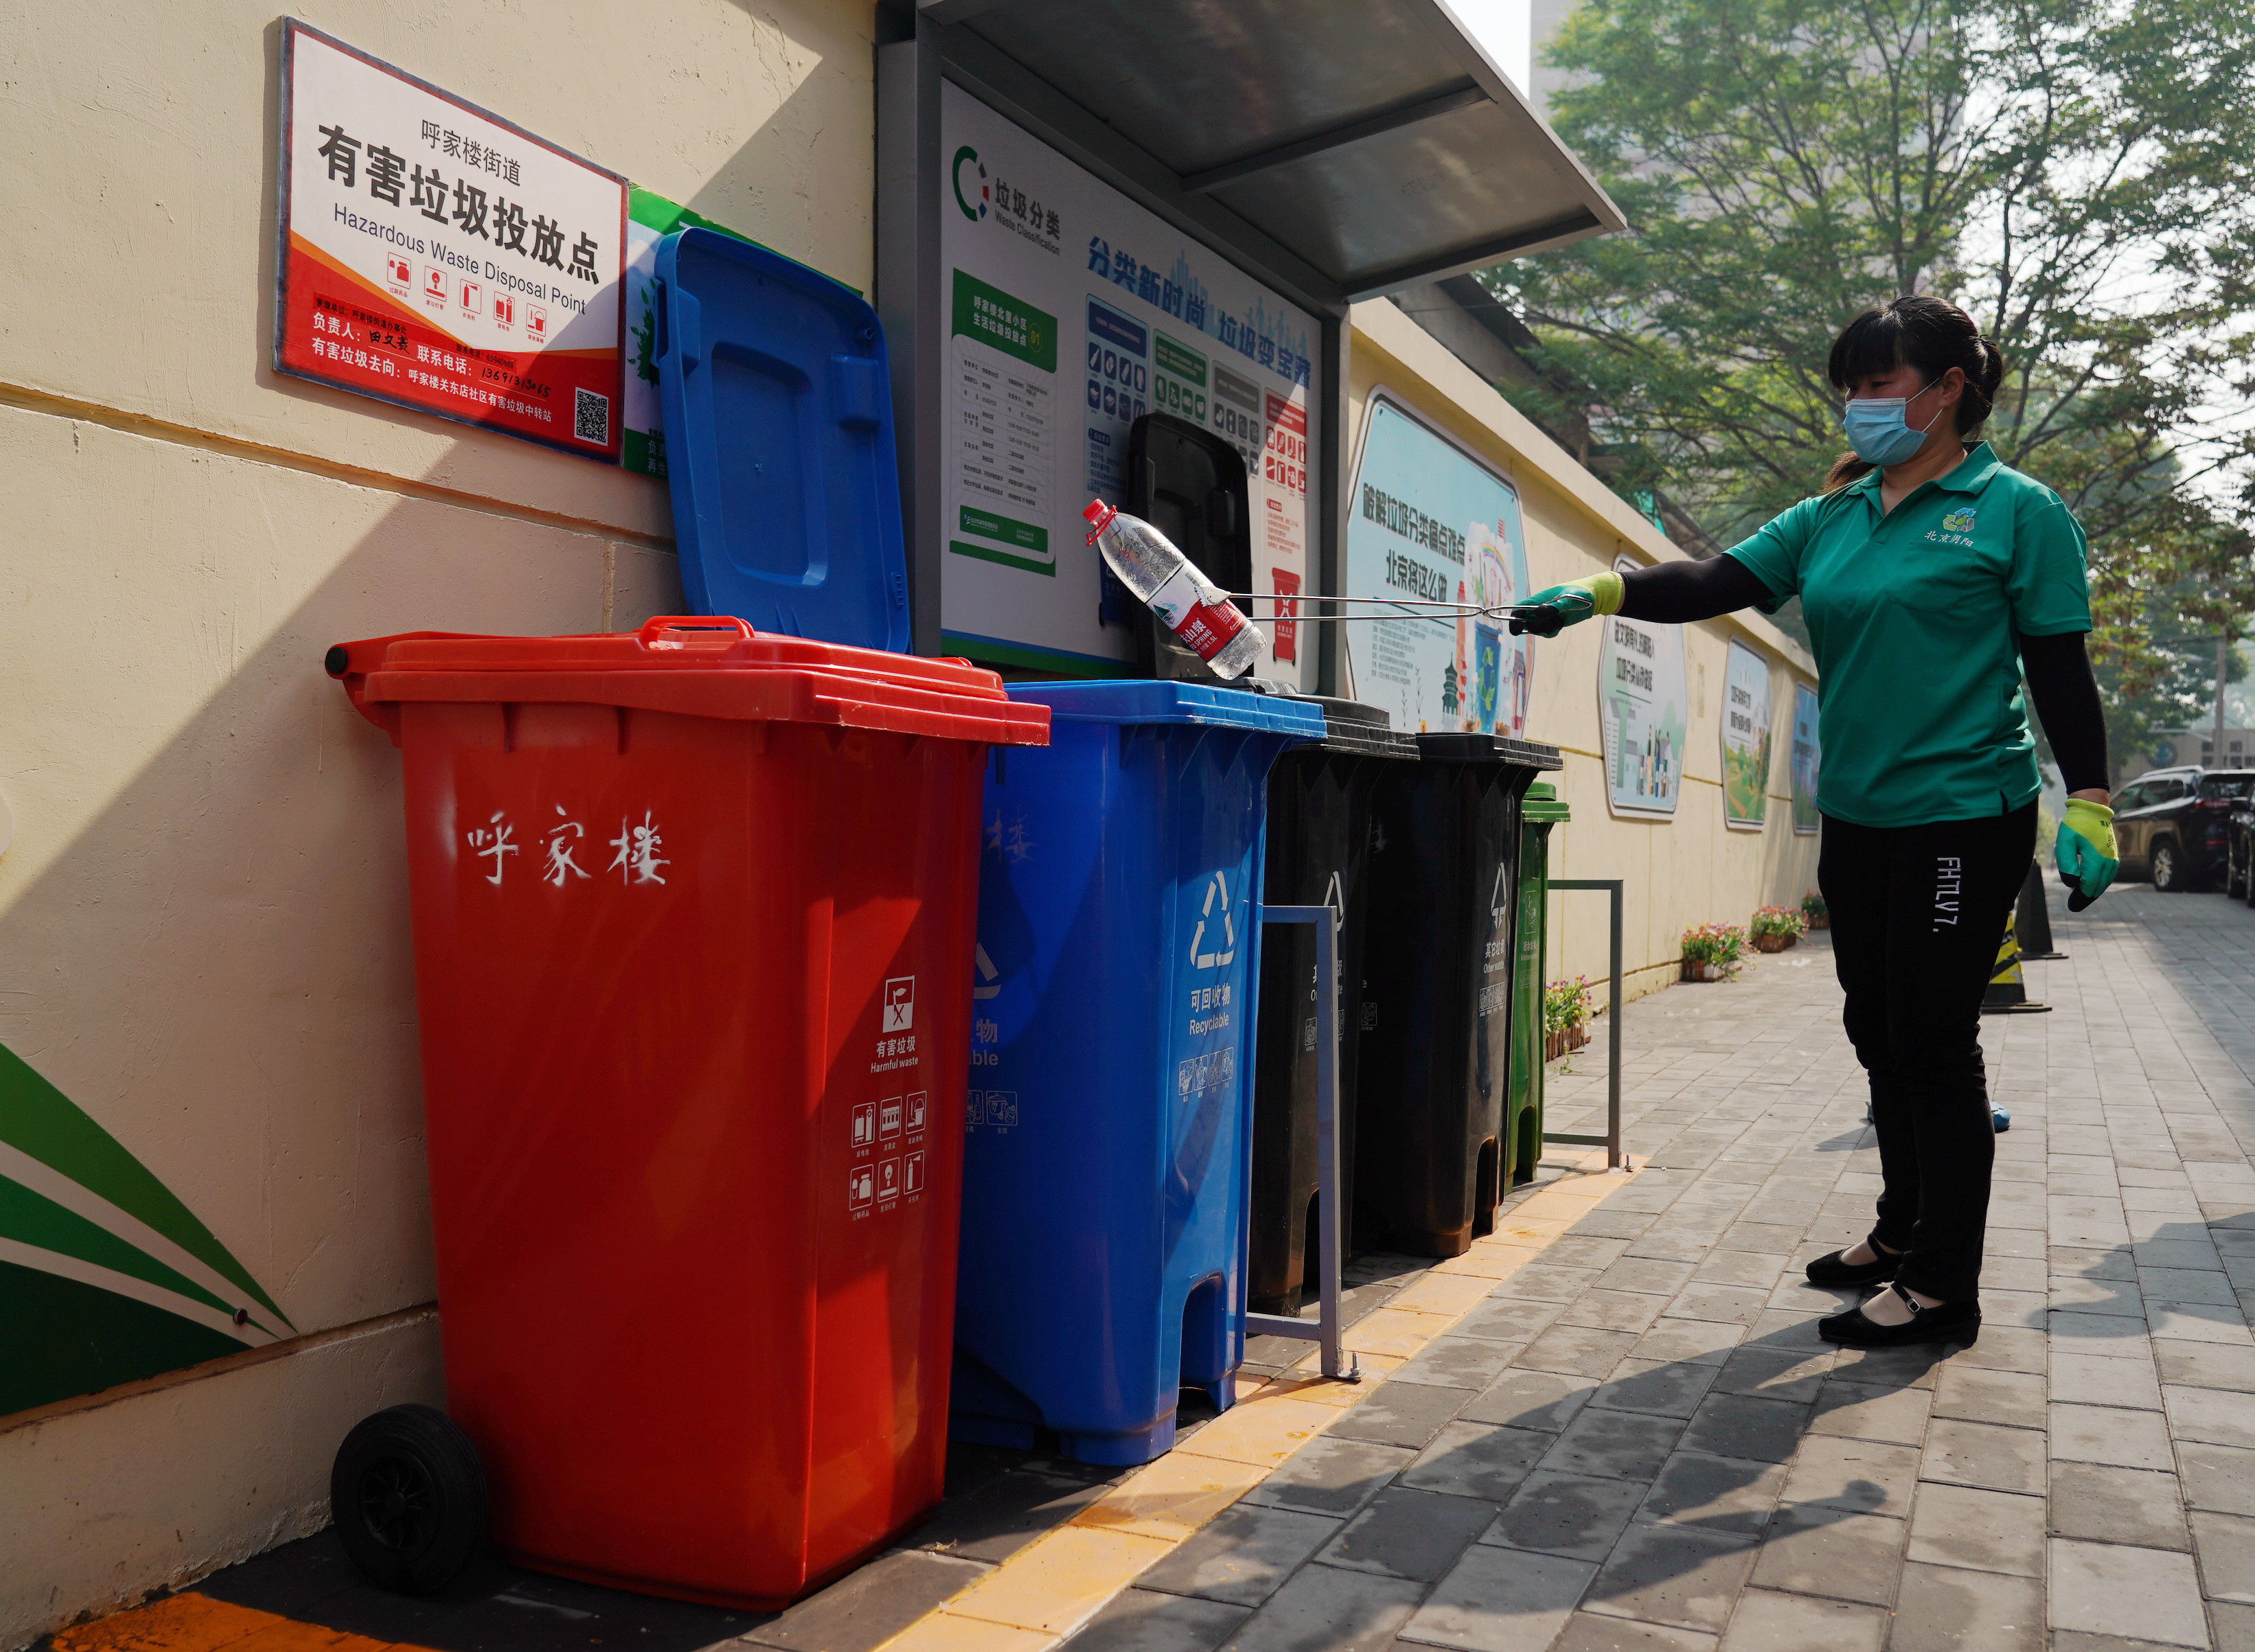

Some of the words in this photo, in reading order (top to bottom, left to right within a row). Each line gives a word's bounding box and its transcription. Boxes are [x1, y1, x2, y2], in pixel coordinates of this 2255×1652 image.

[421, 119, 521, 187] 呼家楼街道
[318, 125, 599, 285] 有害垃圾投放点
[996, 178, 1060, 240] 垃圾分类
[995, 209, 1015, 231] Waste
[1017, 223, 1060, 256] Classification
[334, 203, 424, 254] Hazardous
[431, 240, 479, 275] Waste
[485, 261, 546, 300] Disposal
[551, 286, 586, 315] Point
[313, 311, 360, 342] 负责人：
[1087, 236, 1205, 332] 分类新时尚
[1218, 311, 1311, 389] 垃圾变宝藏
[417, 345, 472, 376] 联系电话：
[312, 336, 400, 378] 有害垃圾去向：
[408, 369, 551, 422] 呼家楼关东店社区有害垃圾中转站
[1195, 629, 1213, 646] SPRING
[467, 803, 672, 887] 呼家楼
[1191, 982, 1230, 1013] 可回收物
[971, 1018, 998, 1044] 物
[1189, 1011, 1229, 1036] Recyclable
[876, 1035, 915, 1058] 有害垃圾
[970, 1049, 998, 1066] ble
[871, 1058, 898, 1073] Harmful
[899, 1056, 919, 1068] waste
